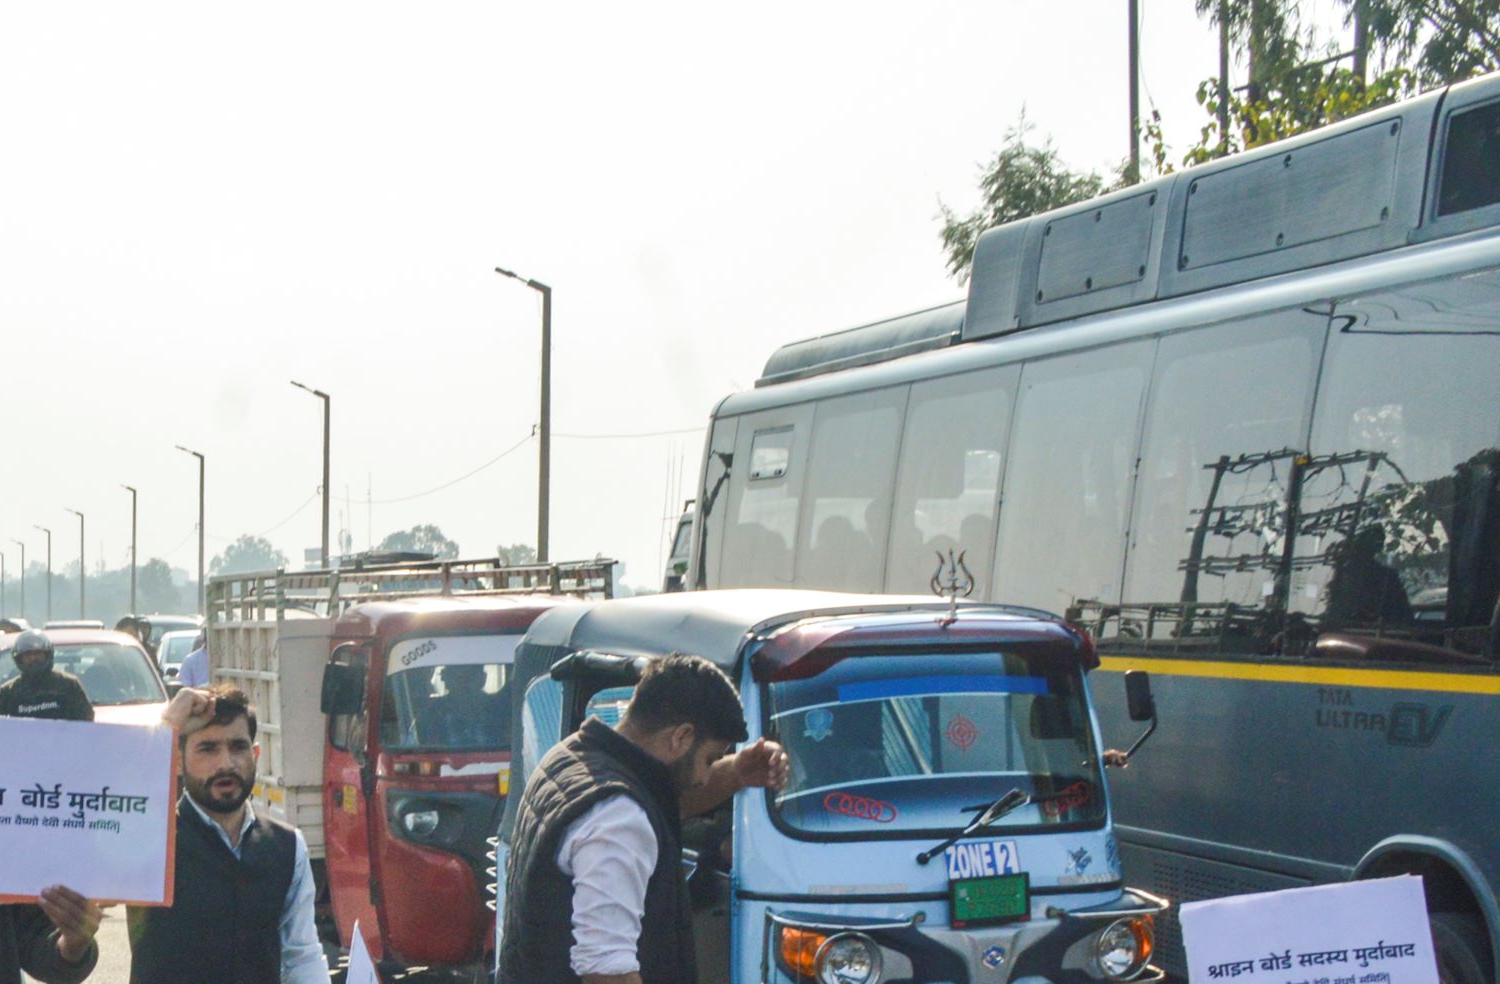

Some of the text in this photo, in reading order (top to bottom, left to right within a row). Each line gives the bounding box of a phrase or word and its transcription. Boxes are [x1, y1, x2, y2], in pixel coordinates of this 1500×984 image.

[401, 639, 438, 666] GOODS
[1317, 687, 1353, 705] TATA
[1316, 709, 1385, 731] ULTRA
[20, 783, 62, 809] बोर्ड
[67, 786, 149, 818] मुर्दाबाद
[945, 842, 1013, 880] ZONE 2
[1208, 941, 1416, 979] श्राइन बोर्ड सदस्य मुर्दाबाद
